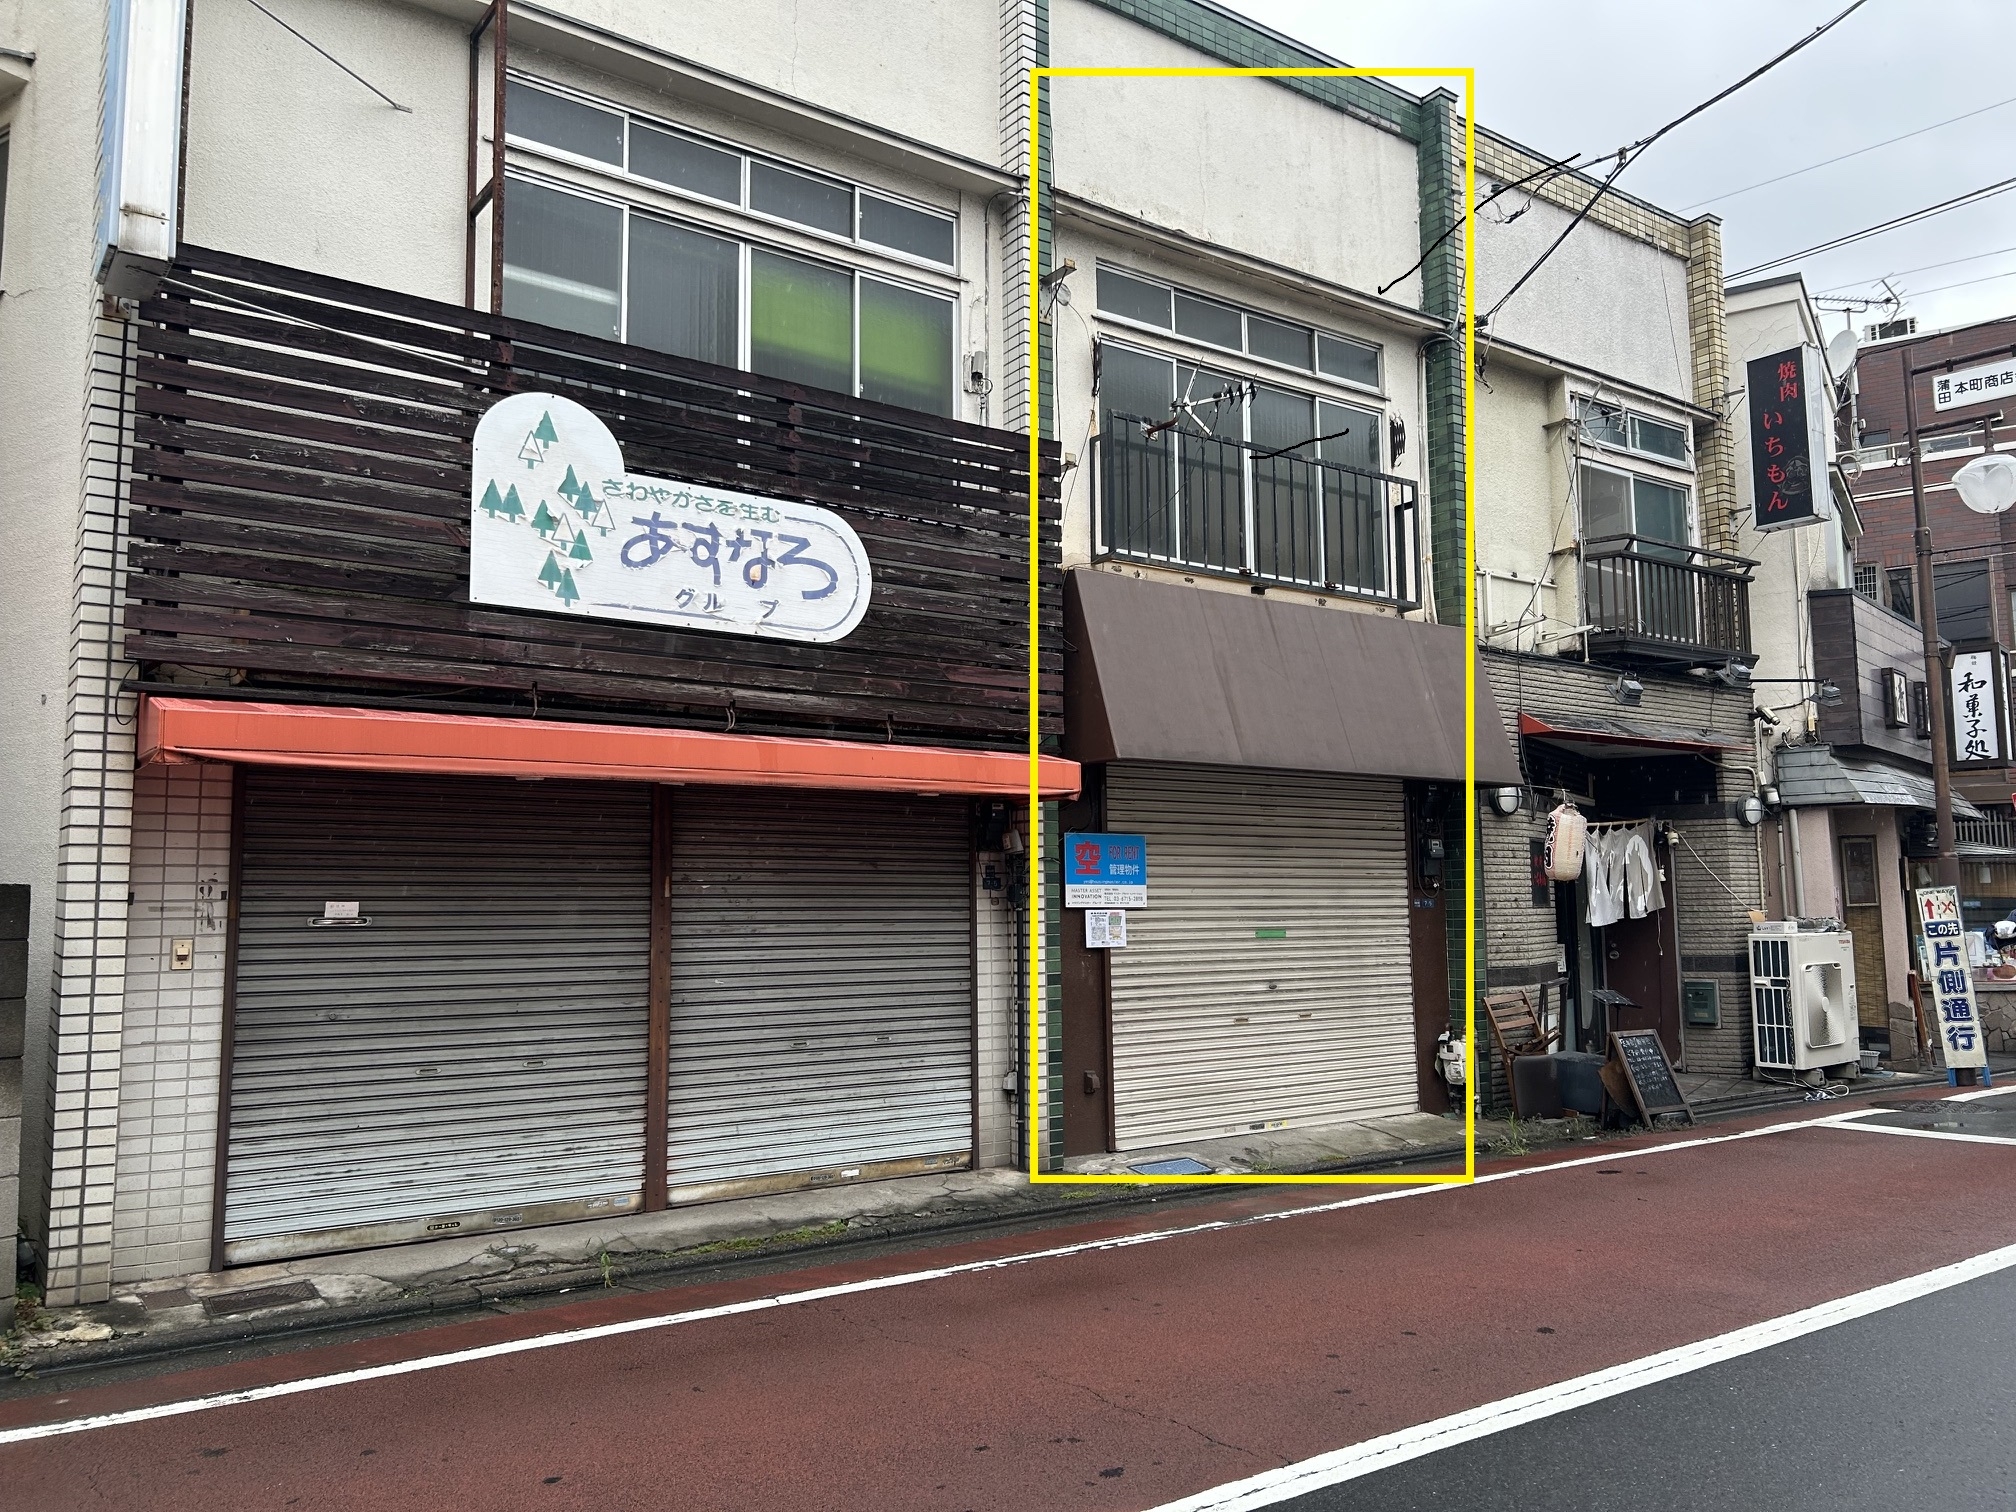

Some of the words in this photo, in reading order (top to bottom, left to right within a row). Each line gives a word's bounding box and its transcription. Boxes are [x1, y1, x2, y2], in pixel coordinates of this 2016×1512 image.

[1777, 360, 1798, 402] 焼肉
[1937, 379, 1952, 404] 蒲田
[1954, 371, 2016, 394] 本町商店
[1763, 411, 1788, 512] いちもん
[602, 478, 780, 523] さわやかさを生む
[620, 511, 839, 600] あすなろ
[675, 588, 780, 619] グルプ
[1957, 672, 1992, 760] 和菓子処
[1075, 841, 1102, 875] 空
[1108, 845, 1122, 860] FOR
[1124, 846, 1140, 860] RENT
[1109, 863, 1140, 876] 管理物件
[1928, 922, 1959, 936] この先
[1933, 940, 1978, 1052] 片側通行
